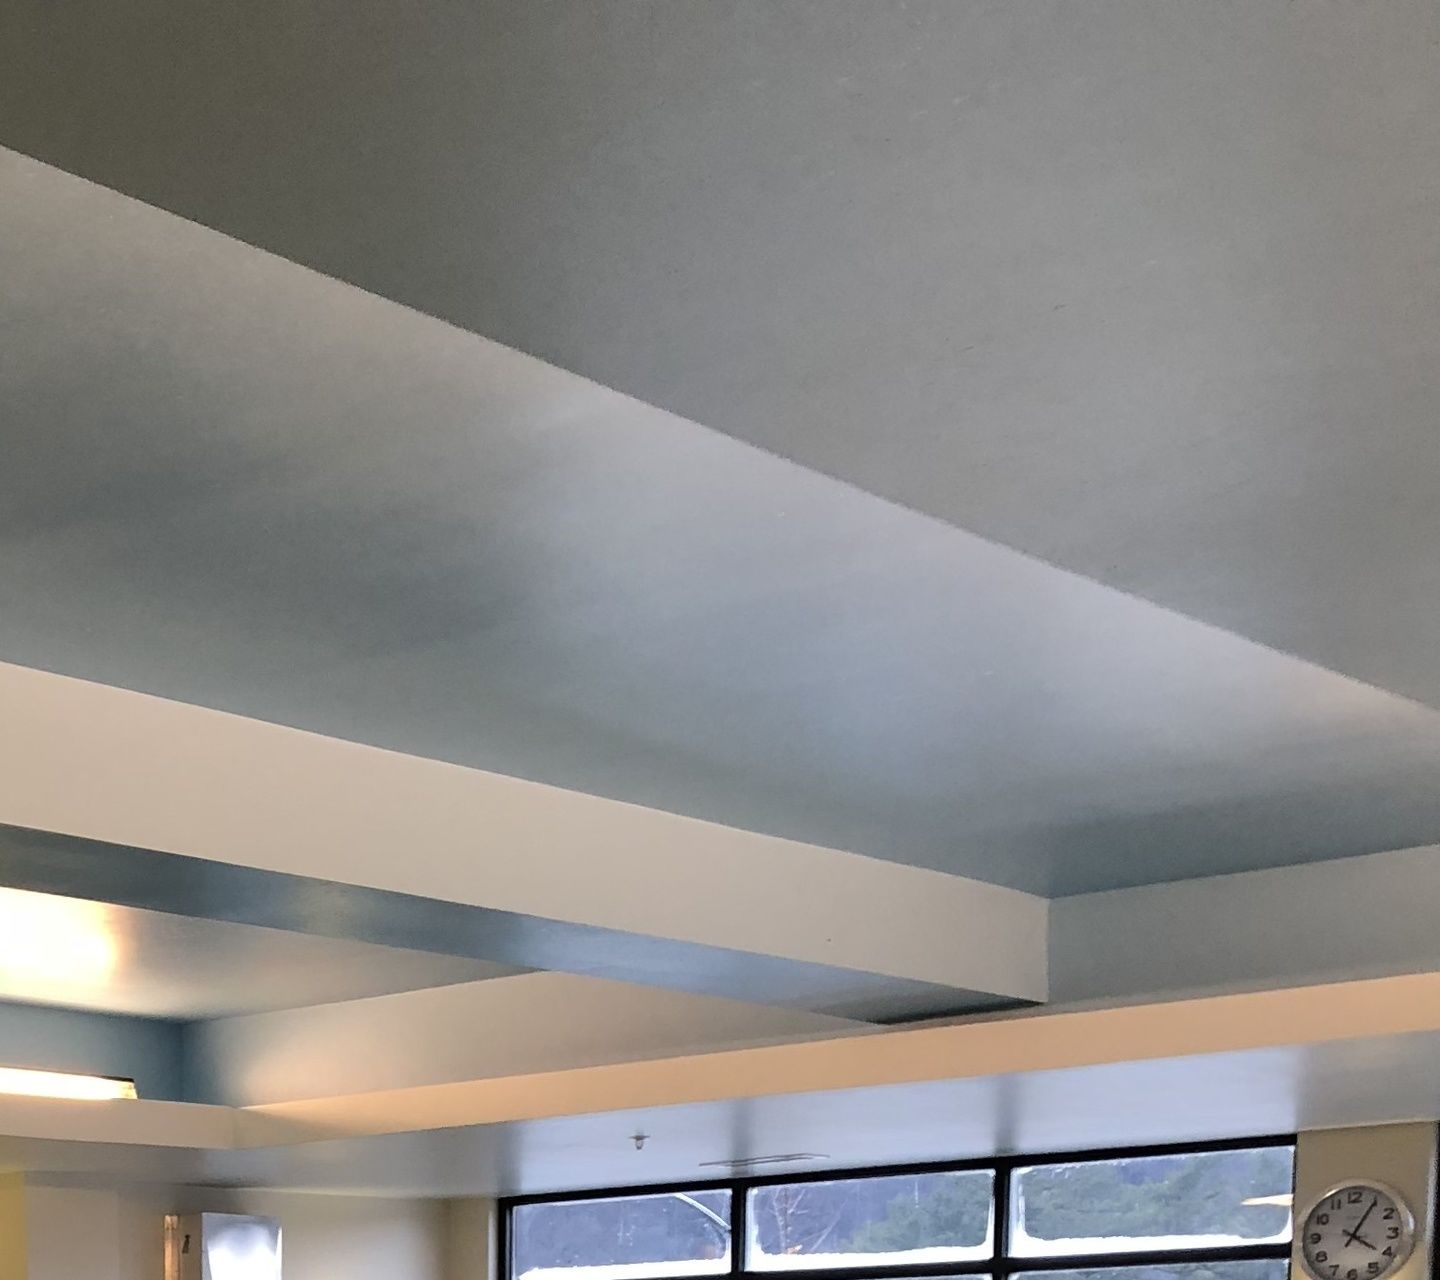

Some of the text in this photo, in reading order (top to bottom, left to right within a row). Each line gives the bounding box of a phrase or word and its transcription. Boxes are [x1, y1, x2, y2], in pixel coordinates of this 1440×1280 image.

[1347, 1191, 1362, 1204] 12
[1330, 1199, 1342, 1210] 11
[1316, 1213, 1329, 1225] 10
[1383, 1207, 1395, 1220] 2
[1310, 1232, 1322, 1244] 9
[1386, 1227, 1399, 1239] 3
[1315, 1251, 1328, 1263] 8
[1382, 1246, 1393, 1257] 4
[1329, 1264, 1340, 1276] 7
[1367, 1262, 1380, 1274] 5
[1346, 1269, 1358, 1280] 6
